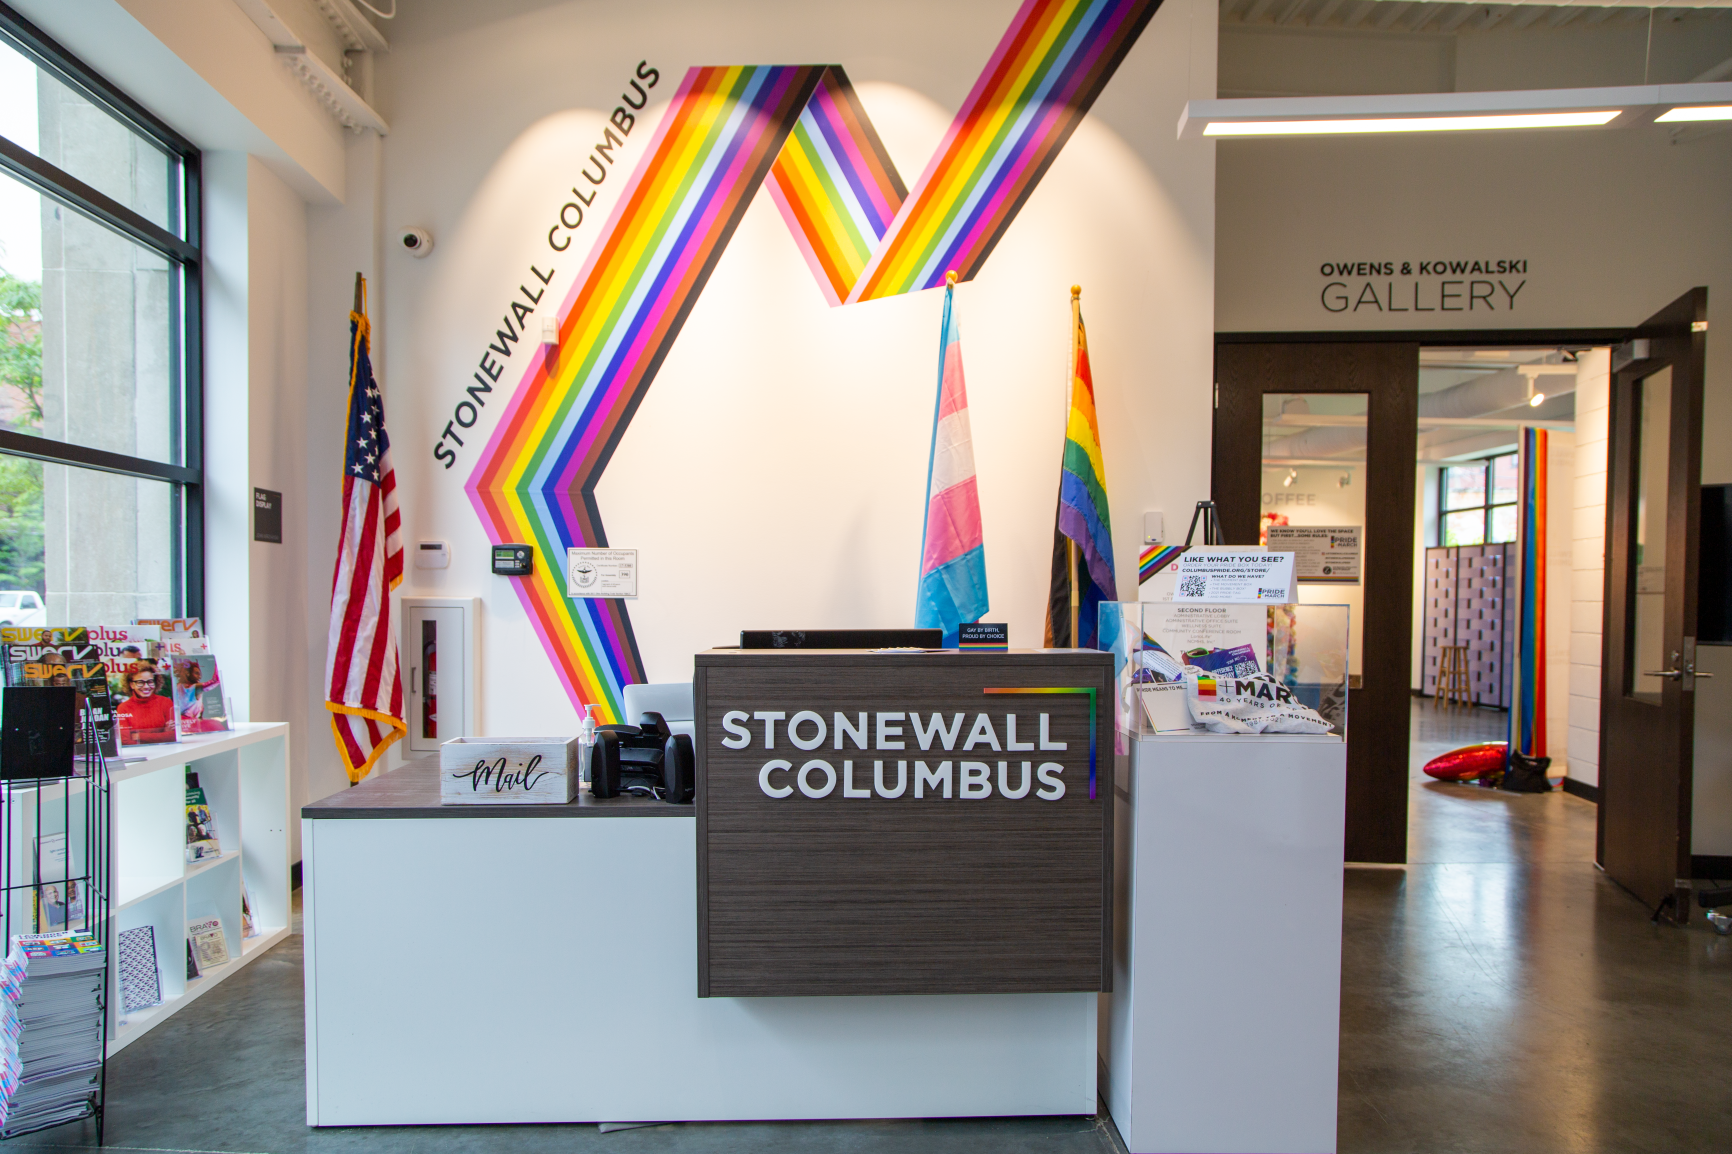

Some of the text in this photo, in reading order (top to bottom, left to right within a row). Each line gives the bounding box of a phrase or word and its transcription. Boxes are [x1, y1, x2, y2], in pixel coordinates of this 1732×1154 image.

[433, 59, 660, 470] STONEWALL COLUMBUS
[1320, 259, 1528, 277] OWENS & KOWALSKI
[1321, 279, 1527, 313] GALLERY
[1236, 697, 1265, 709] YEARS
[721, 709, 1068, 752] STONEWALL
[452, 754, 550, 792] Mail
[758, 758, 1067, 801] COLUMBUS
